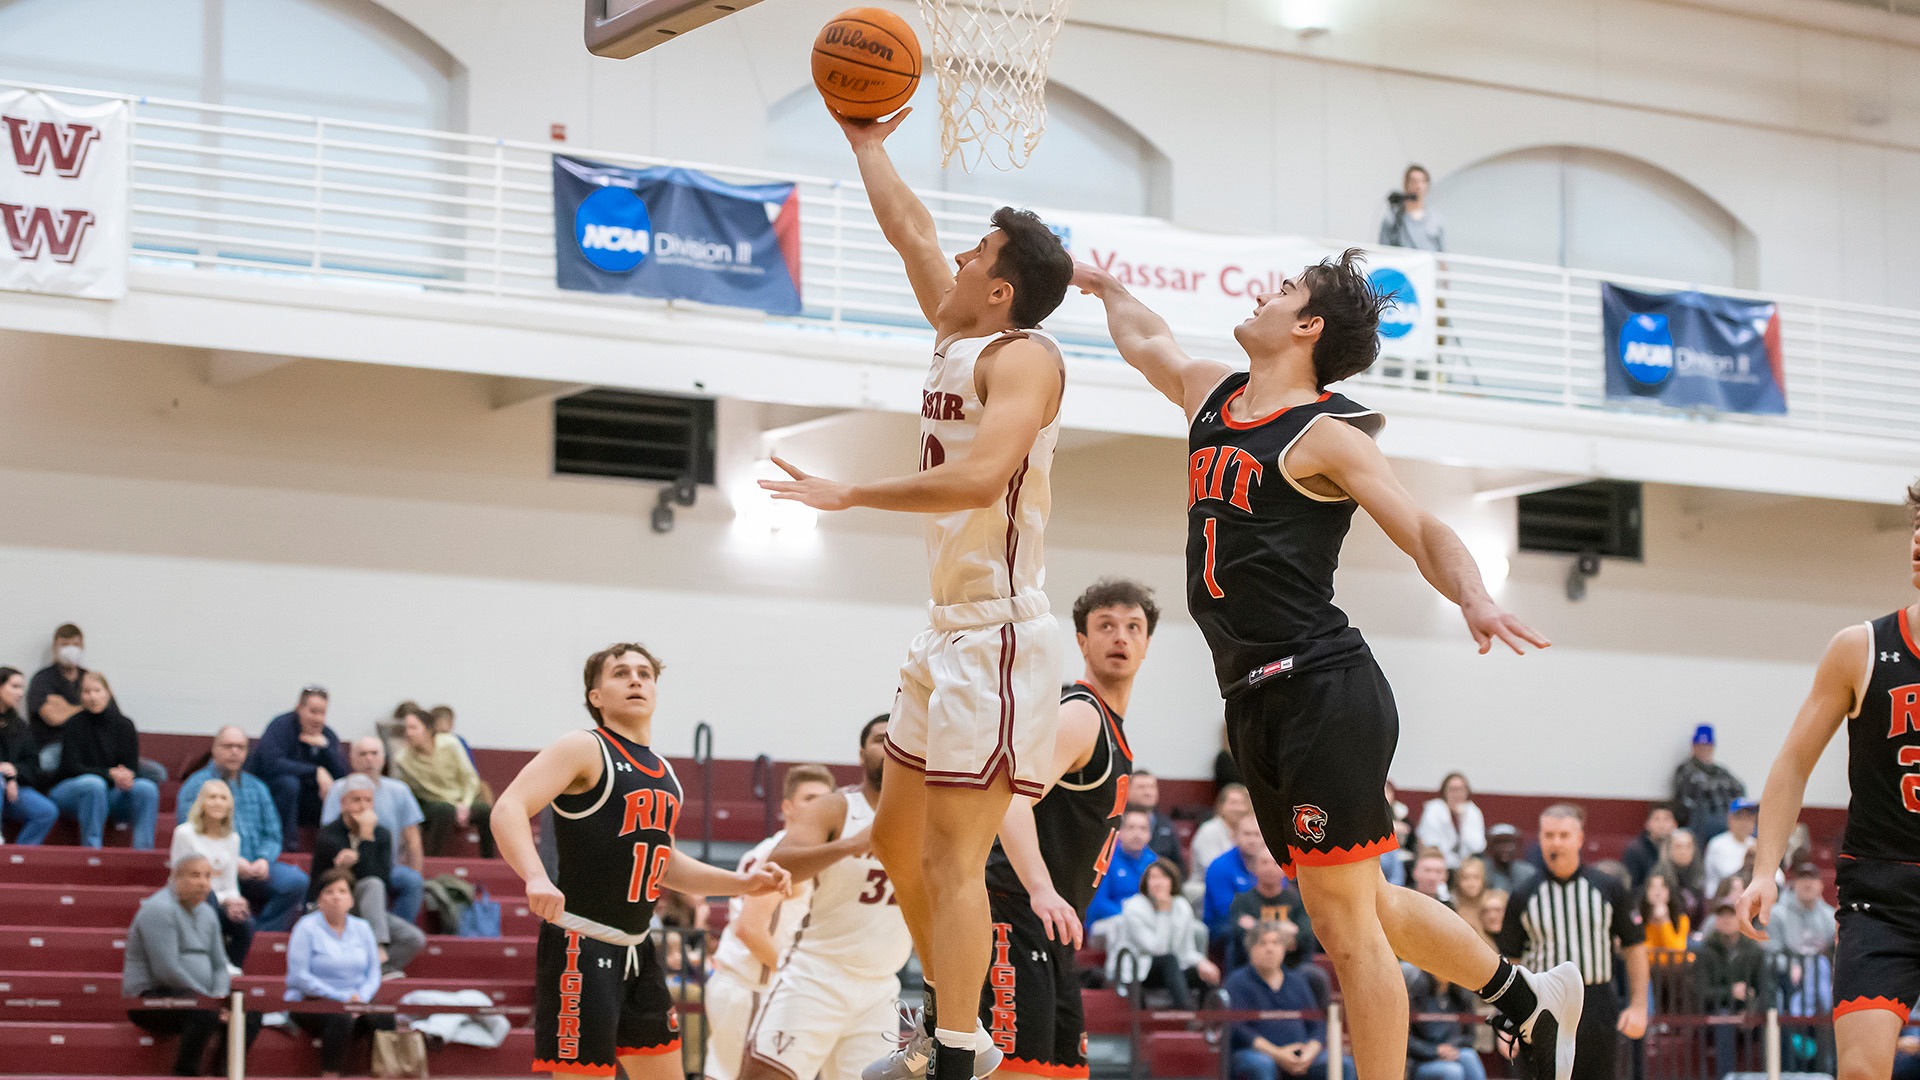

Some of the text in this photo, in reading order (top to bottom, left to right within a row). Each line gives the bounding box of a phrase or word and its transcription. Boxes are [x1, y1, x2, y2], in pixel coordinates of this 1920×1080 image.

[825, 26, 894, 61] Wilson
[1, 115, 100, 178] W
[0, 203, 95, 264] W
[582, 223, 650, 255] NCAA
[654, 231, 732, 263] Division
[1090, 248, 1206, 292] Vassar
[1188, 445, 1263, 515] RIT
[1203, 517, 1225, 599] 1
[859, 868, 898, 905] 3
[556, 929, 586, 1060] TIGERS
[989, 922, 1018, 1055] TIGERS
